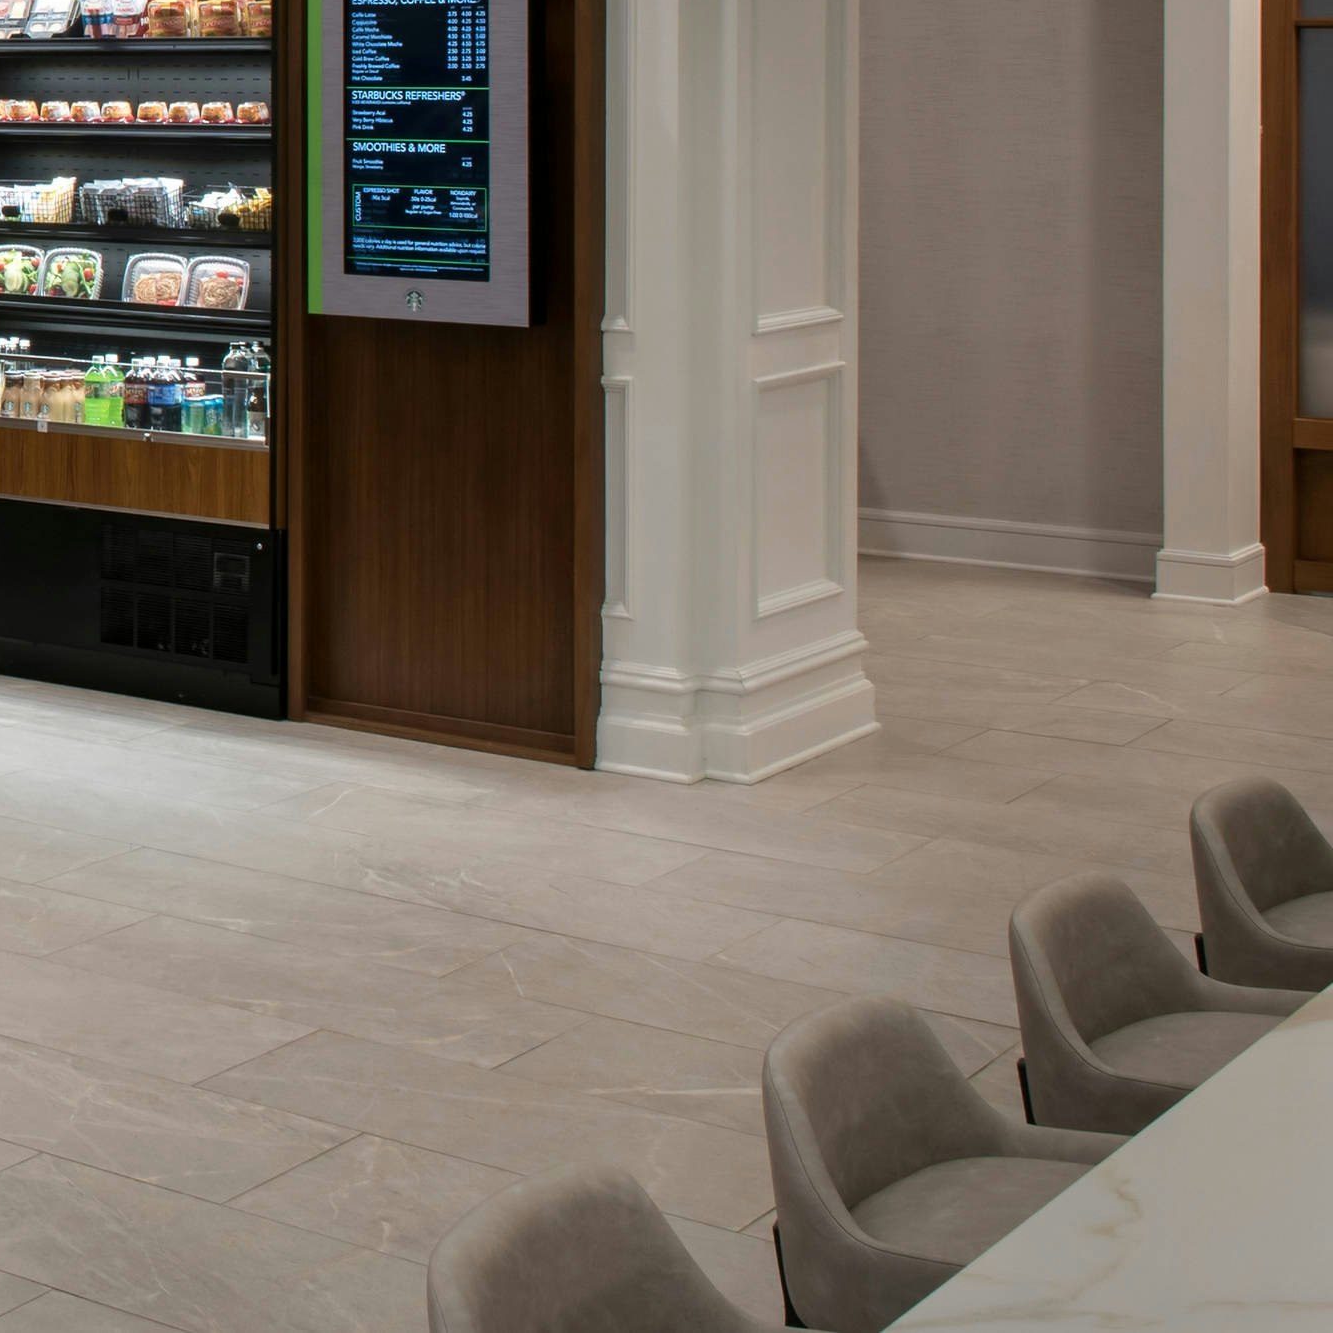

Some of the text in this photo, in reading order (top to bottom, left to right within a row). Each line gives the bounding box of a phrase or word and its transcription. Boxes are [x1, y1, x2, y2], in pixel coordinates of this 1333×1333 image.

[352, 91, 403, 100] STARBUCKS
[353, 142, 446, 153] SMOOTHIES & MORE
